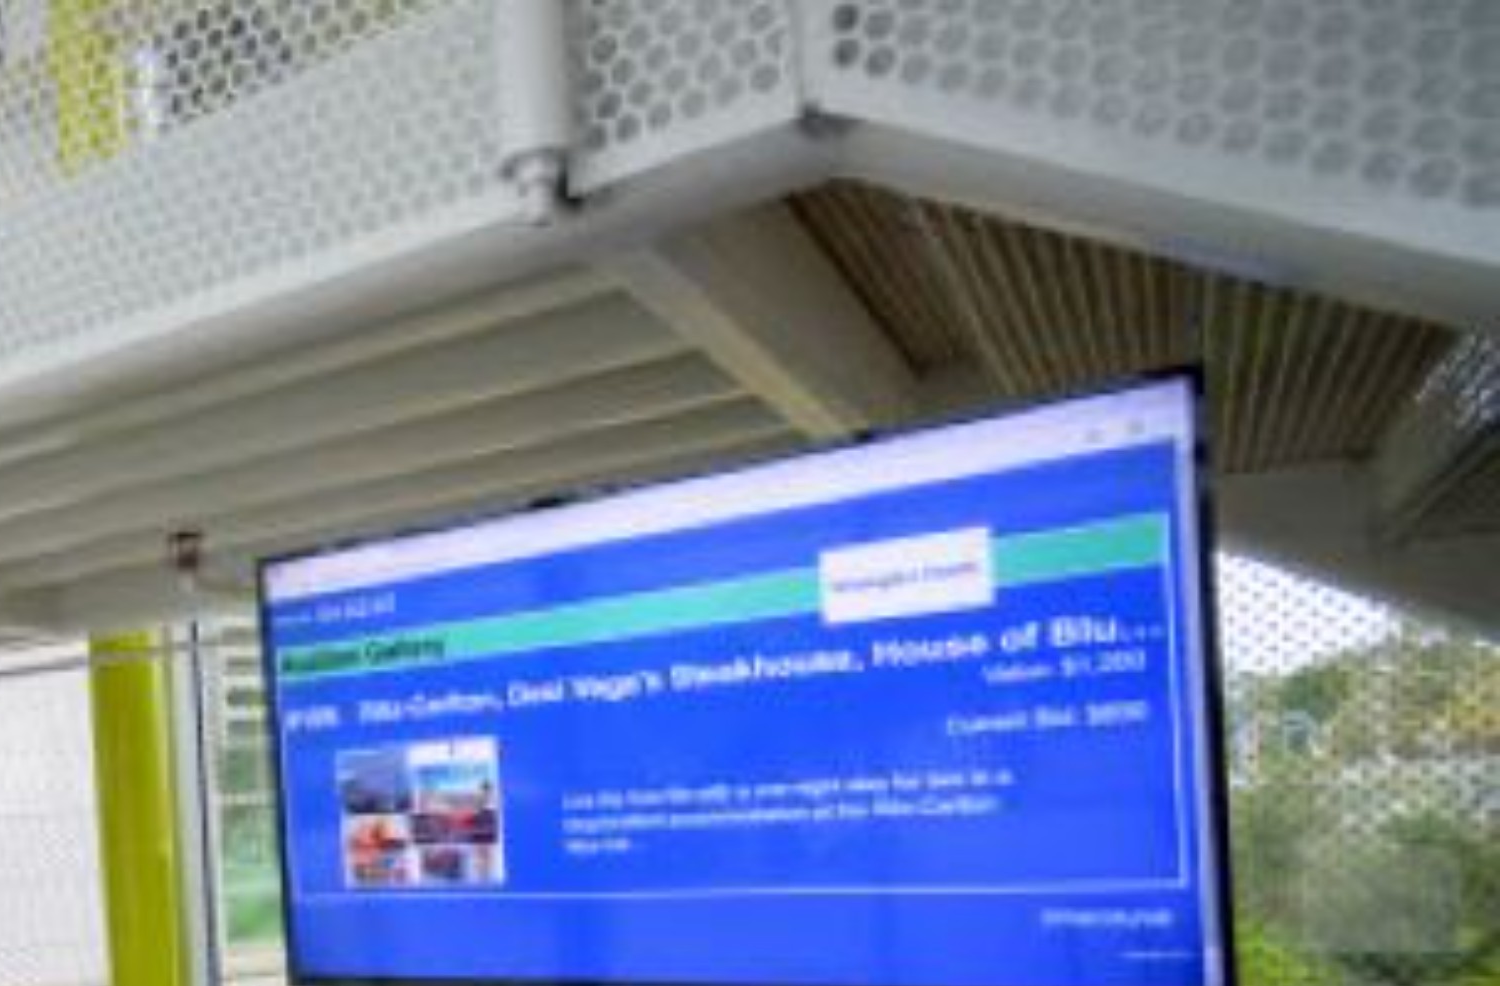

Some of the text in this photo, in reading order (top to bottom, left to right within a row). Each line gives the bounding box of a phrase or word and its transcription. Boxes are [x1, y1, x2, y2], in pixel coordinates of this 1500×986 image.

[363, 638, 446, 668] Gallery
[871, 634, 988, 668] House
[1001, 620, 1039, 653] of
